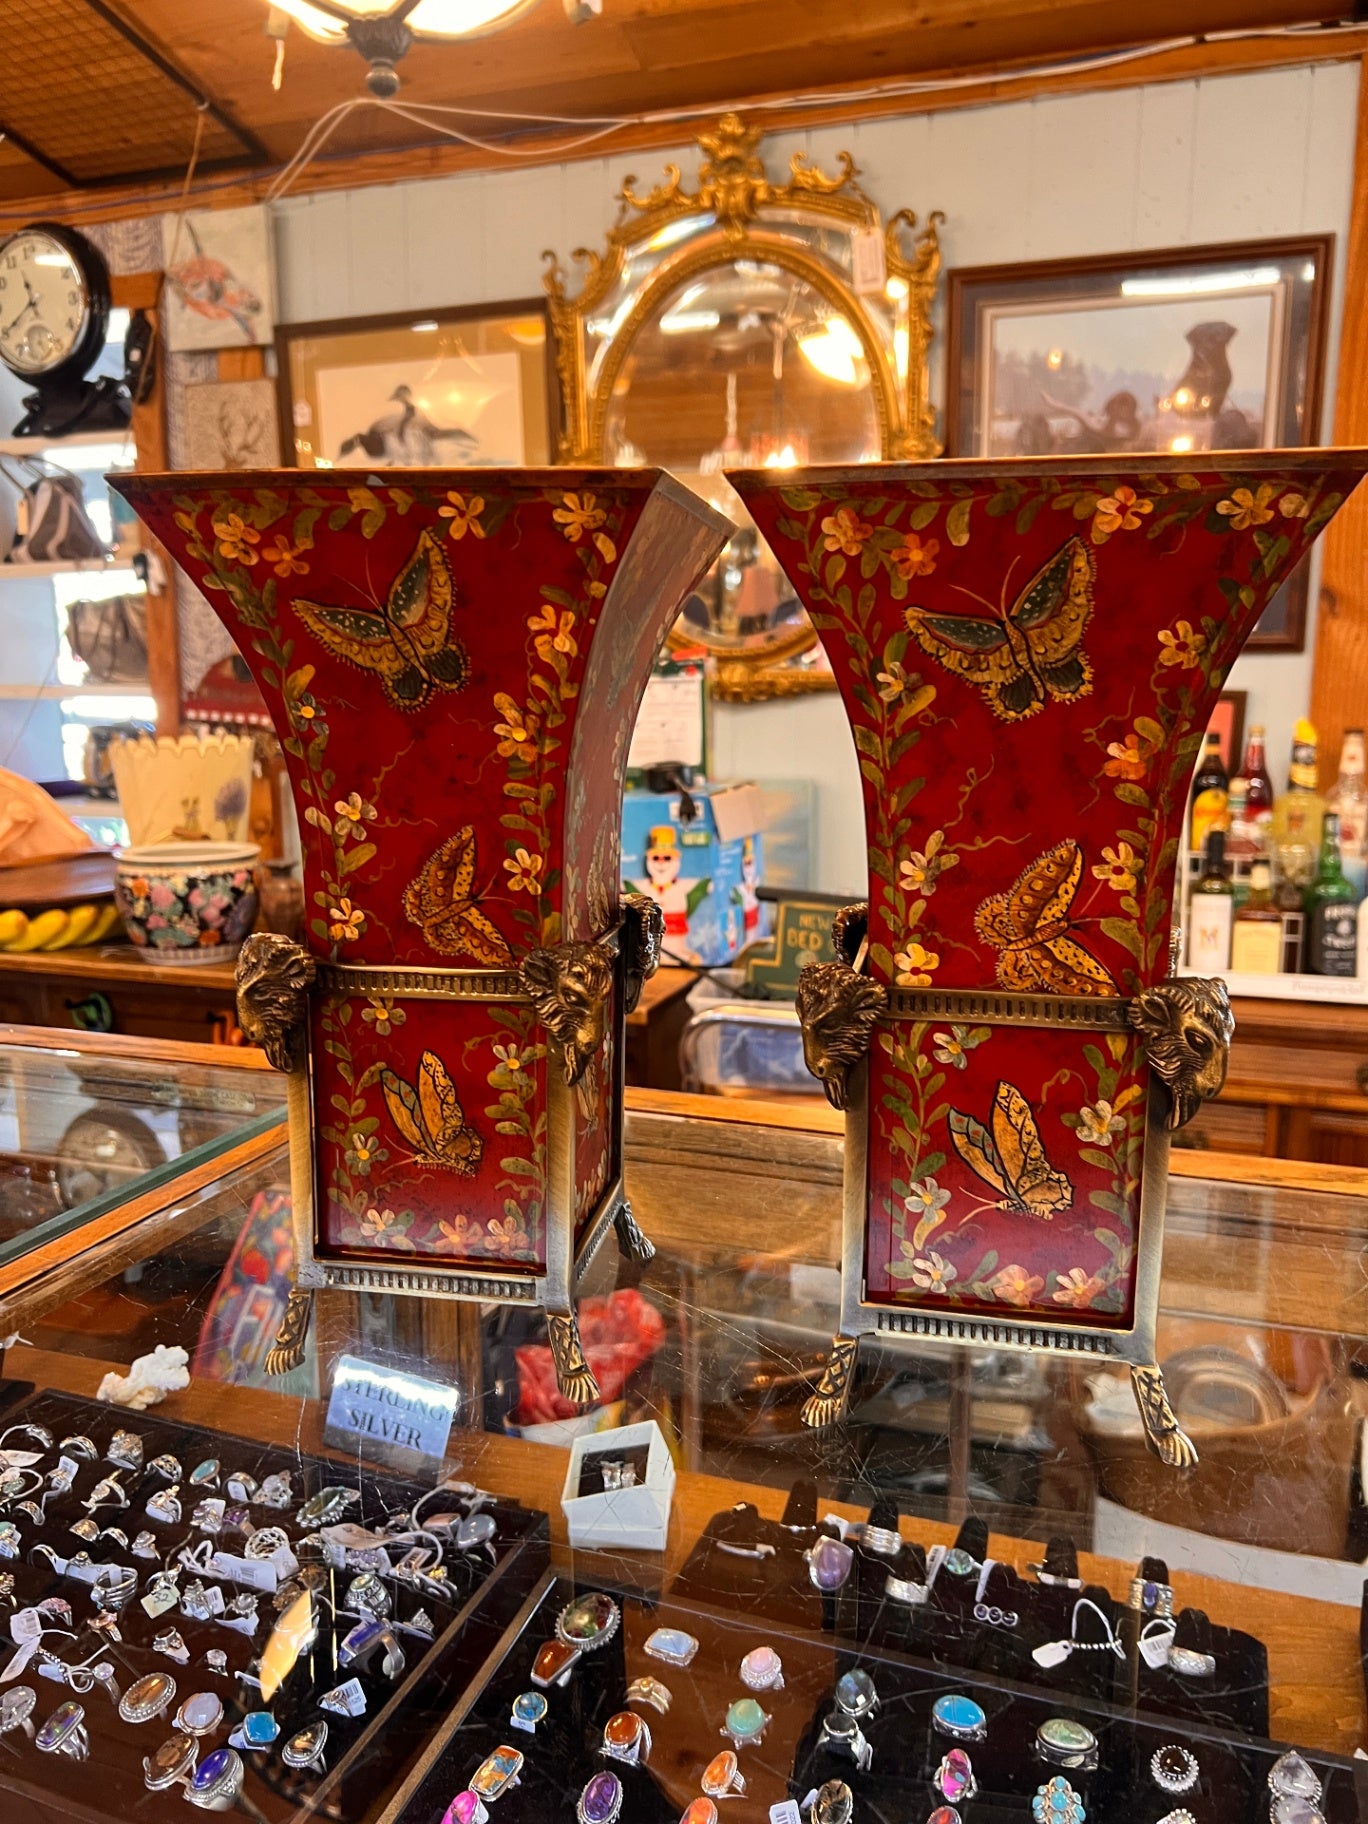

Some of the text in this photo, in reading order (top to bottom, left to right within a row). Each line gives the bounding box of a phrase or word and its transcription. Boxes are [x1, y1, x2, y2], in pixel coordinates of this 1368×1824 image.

[6, 256, 17, 269] 11
[23, 245, 35, 260] 12
[341, 1376, 445, 1422] STERLING
[348, 1407, 422, 1450] SILVER
